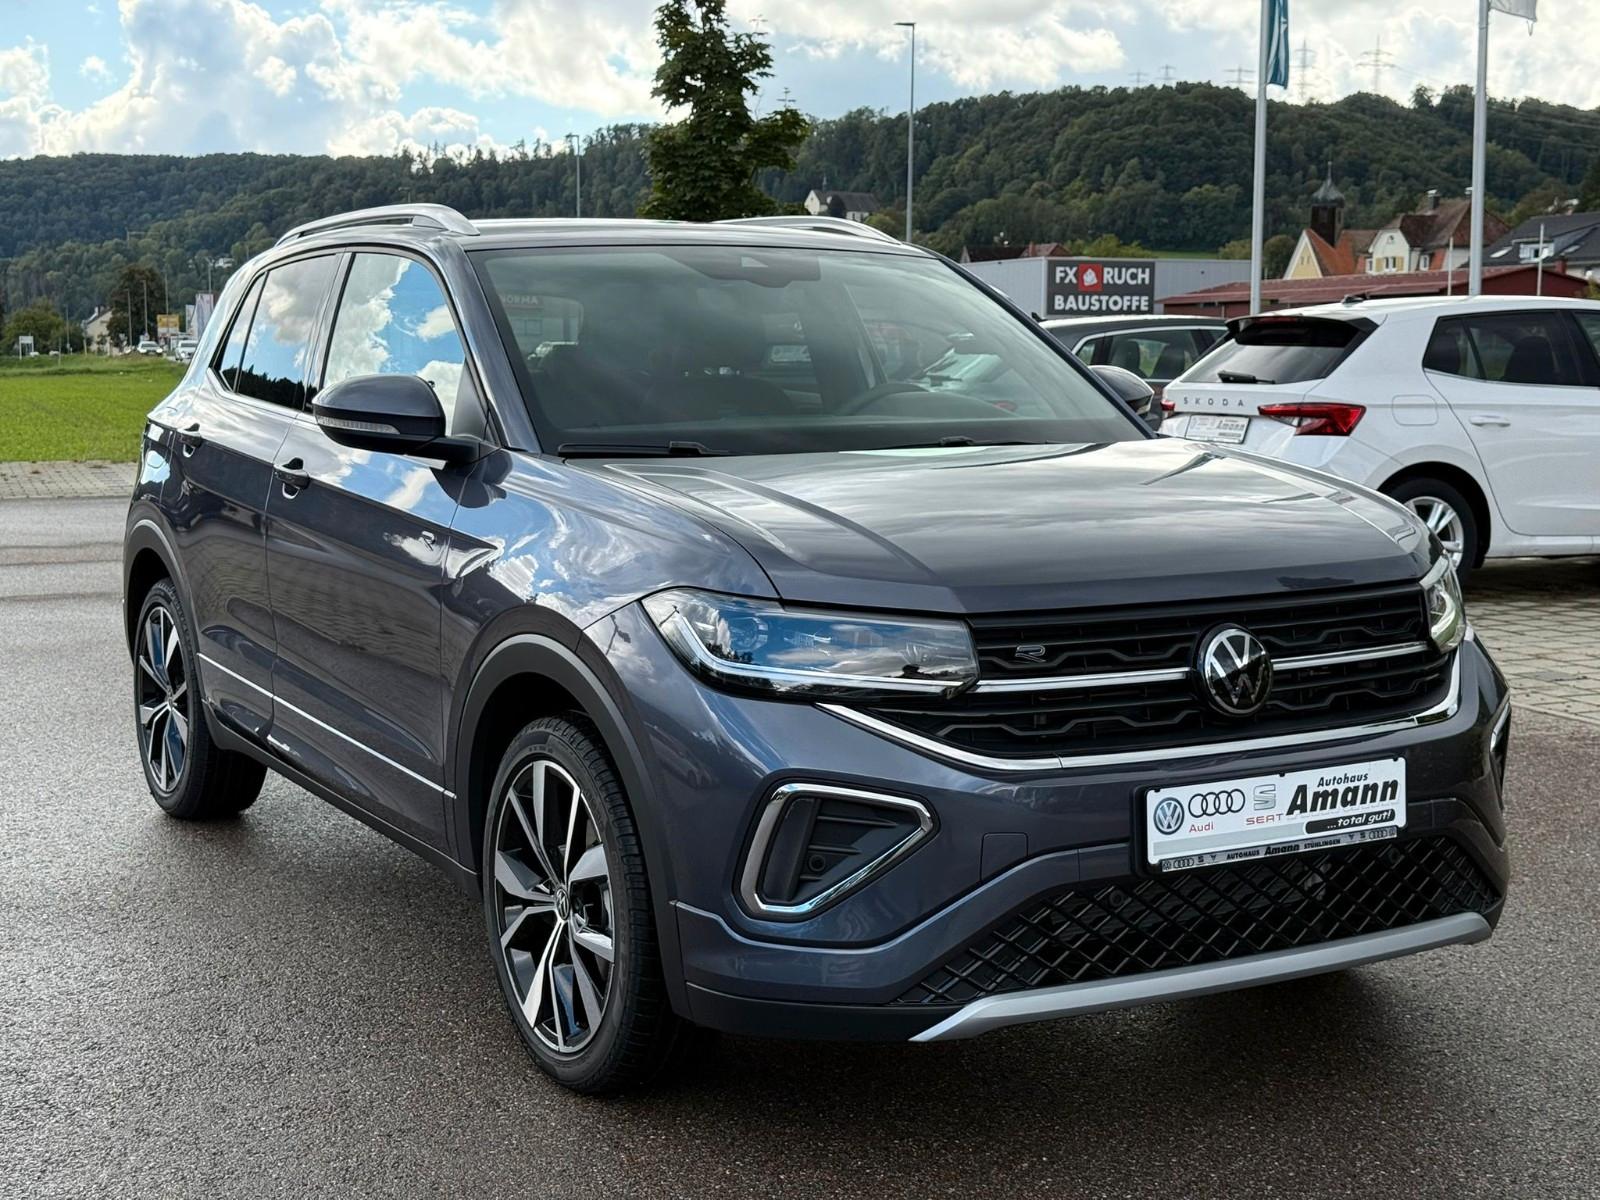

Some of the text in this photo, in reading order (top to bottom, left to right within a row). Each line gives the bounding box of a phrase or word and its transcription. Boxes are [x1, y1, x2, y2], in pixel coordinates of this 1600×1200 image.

[1055, 266, 1150, 285] FX RUCH
[1054, 294, 1149, 311] BAUSTOFFE
[1316, 773, 1369, 789] Autohaus
[1286, 779, 1399, 816] Amann
[1246, 812, 1282, 826] SEAT
[1367, 809, 1392, 826] gut!
[1188, 821, 1214, 833] Audi
[1226, 838, 1341, 861] AUTOHAUS Amann STÜHLINGEN
